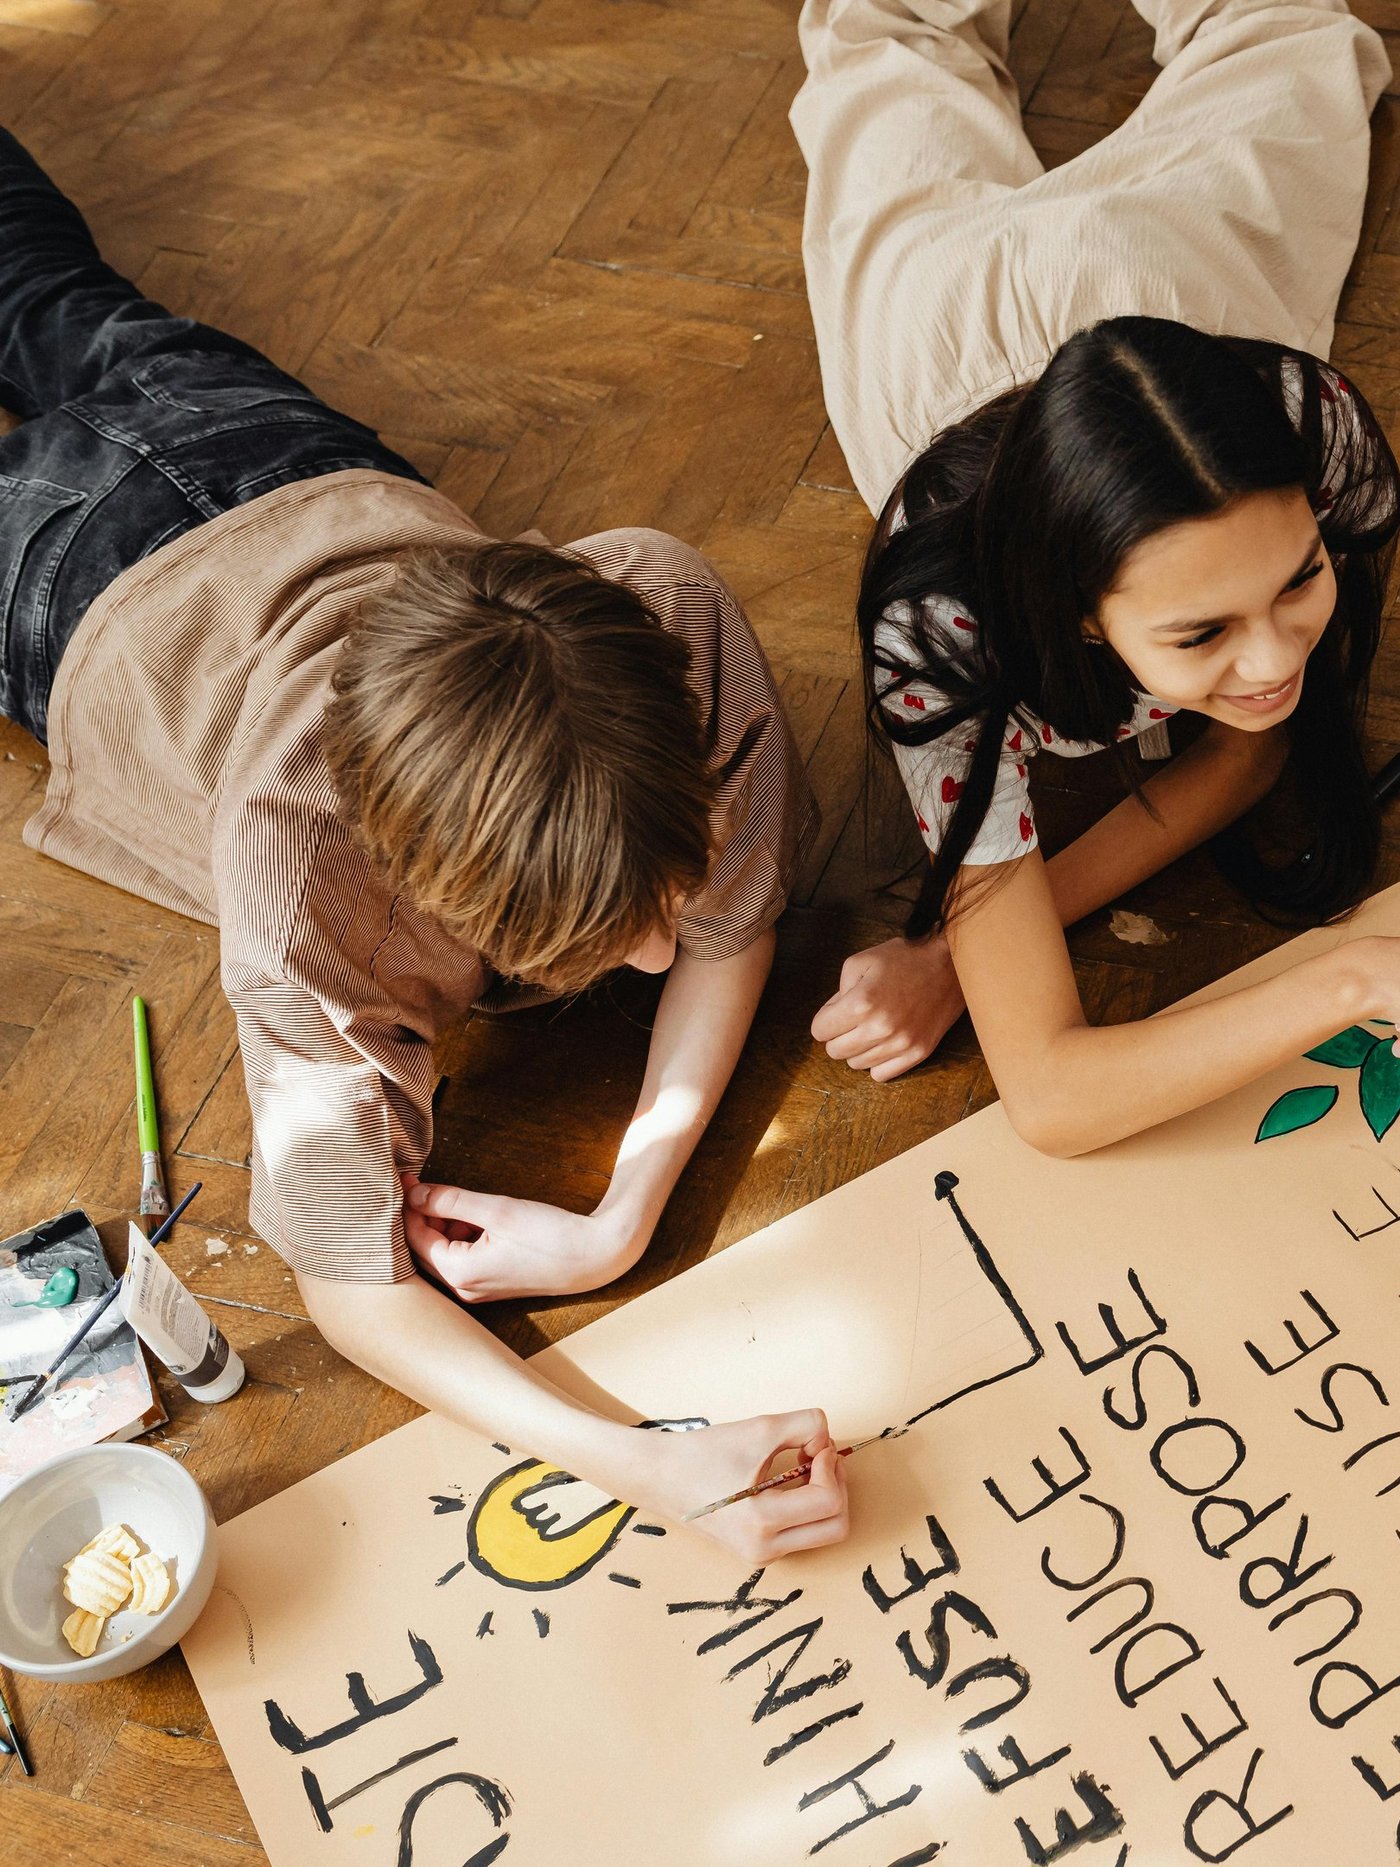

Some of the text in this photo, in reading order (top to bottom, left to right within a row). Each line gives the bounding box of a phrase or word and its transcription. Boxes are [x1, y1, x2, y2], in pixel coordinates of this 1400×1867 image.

[667, 1567, 946, 1867] HINK
[862, 1514, 1130, 1867] EFUSE
[983, 1426, 1294, 1864] REDUCE
